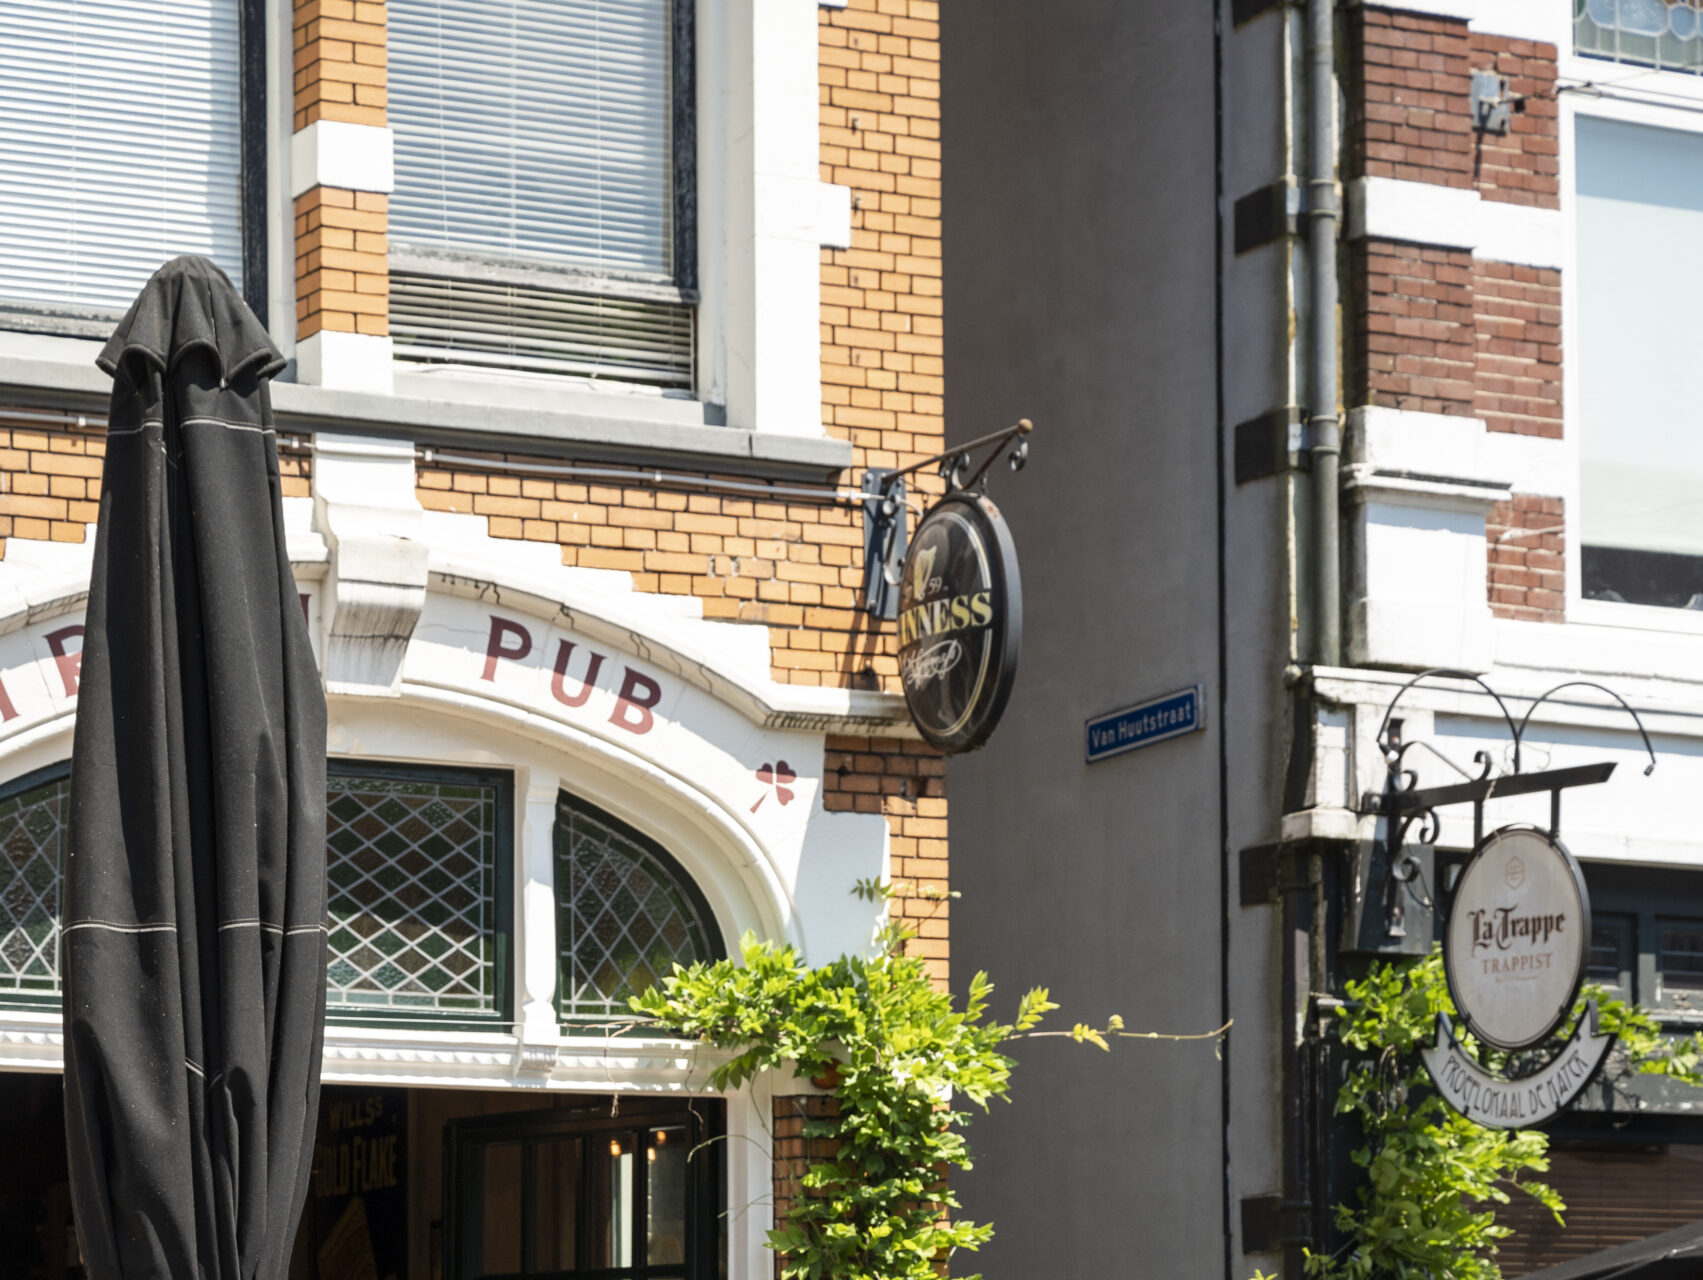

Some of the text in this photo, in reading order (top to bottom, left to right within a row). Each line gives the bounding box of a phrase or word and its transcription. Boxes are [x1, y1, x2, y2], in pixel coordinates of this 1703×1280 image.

[899, 592, 993, 647] INNESS
[481, 615, 662, 735] PUB
[1091, 701, 1192, 748] Van Huutstraat
[1494, 903, 1566, 950] Trappe
[1480, 952, 1553, 974] TRAPPIST
[352, 1135, 397, 1192] FLAKE
